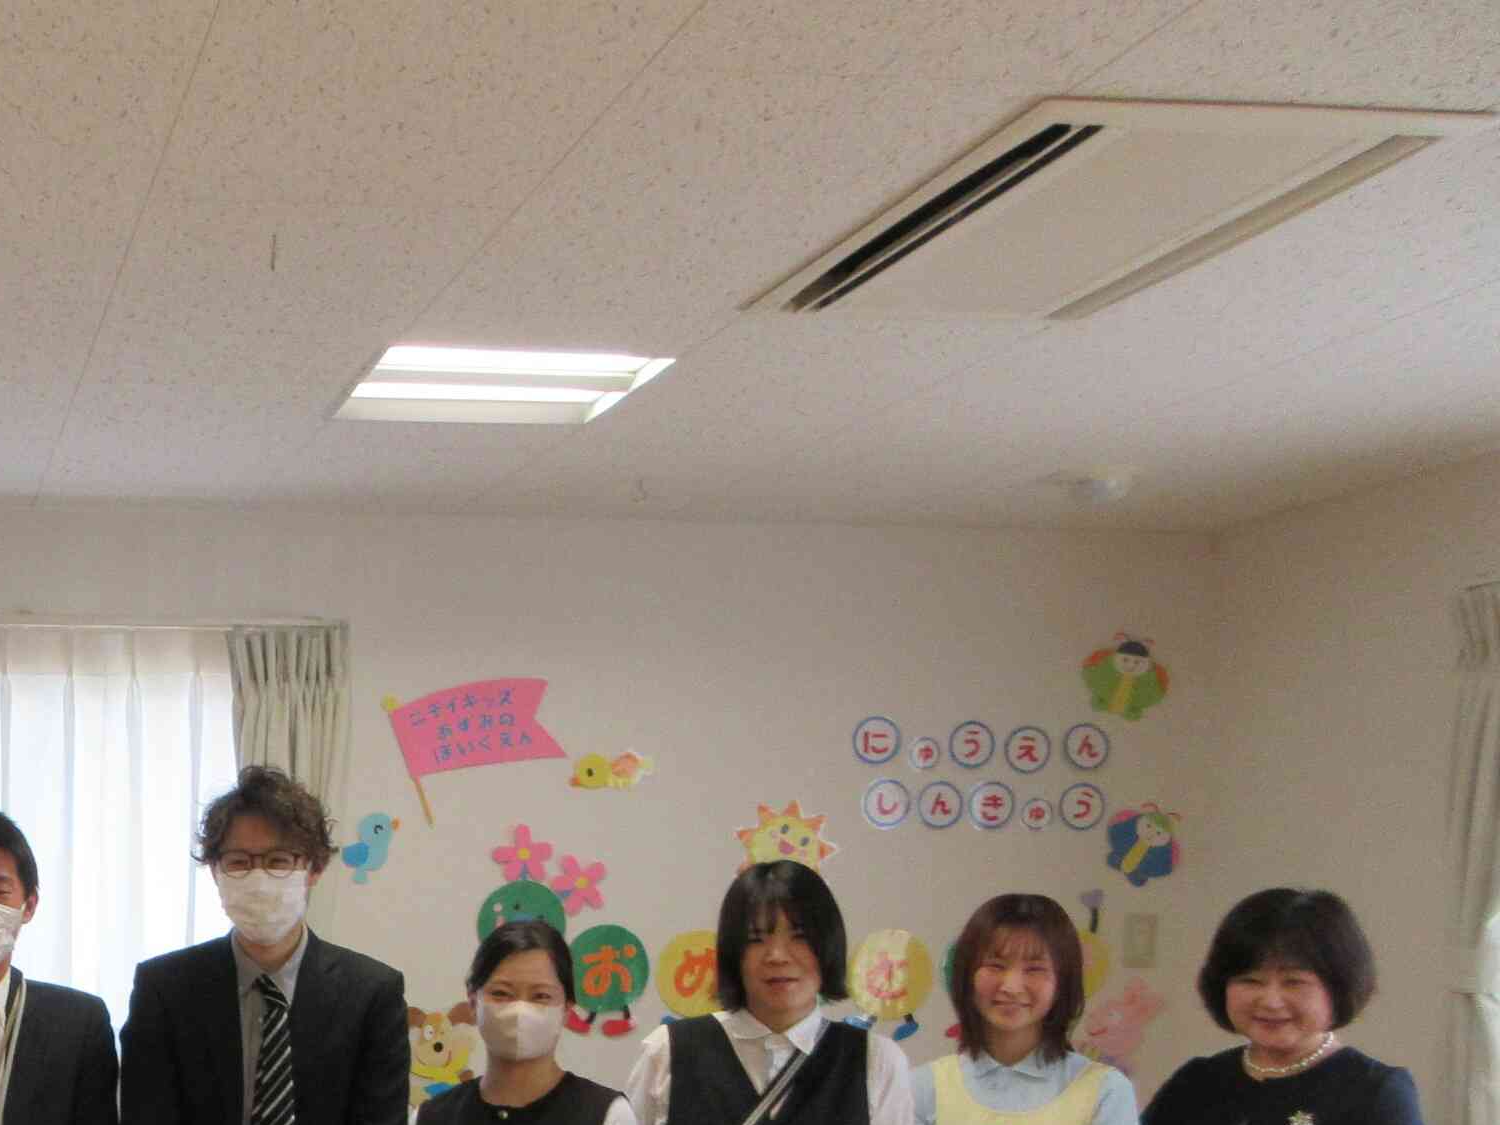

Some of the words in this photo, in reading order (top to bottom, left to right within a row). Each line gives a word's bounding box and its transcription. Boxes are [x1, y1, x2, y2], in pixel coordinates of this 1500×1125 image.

[861, 729, 1101, 764] にゅうえん
[874, 789, 1096, 823] しんきゅう
